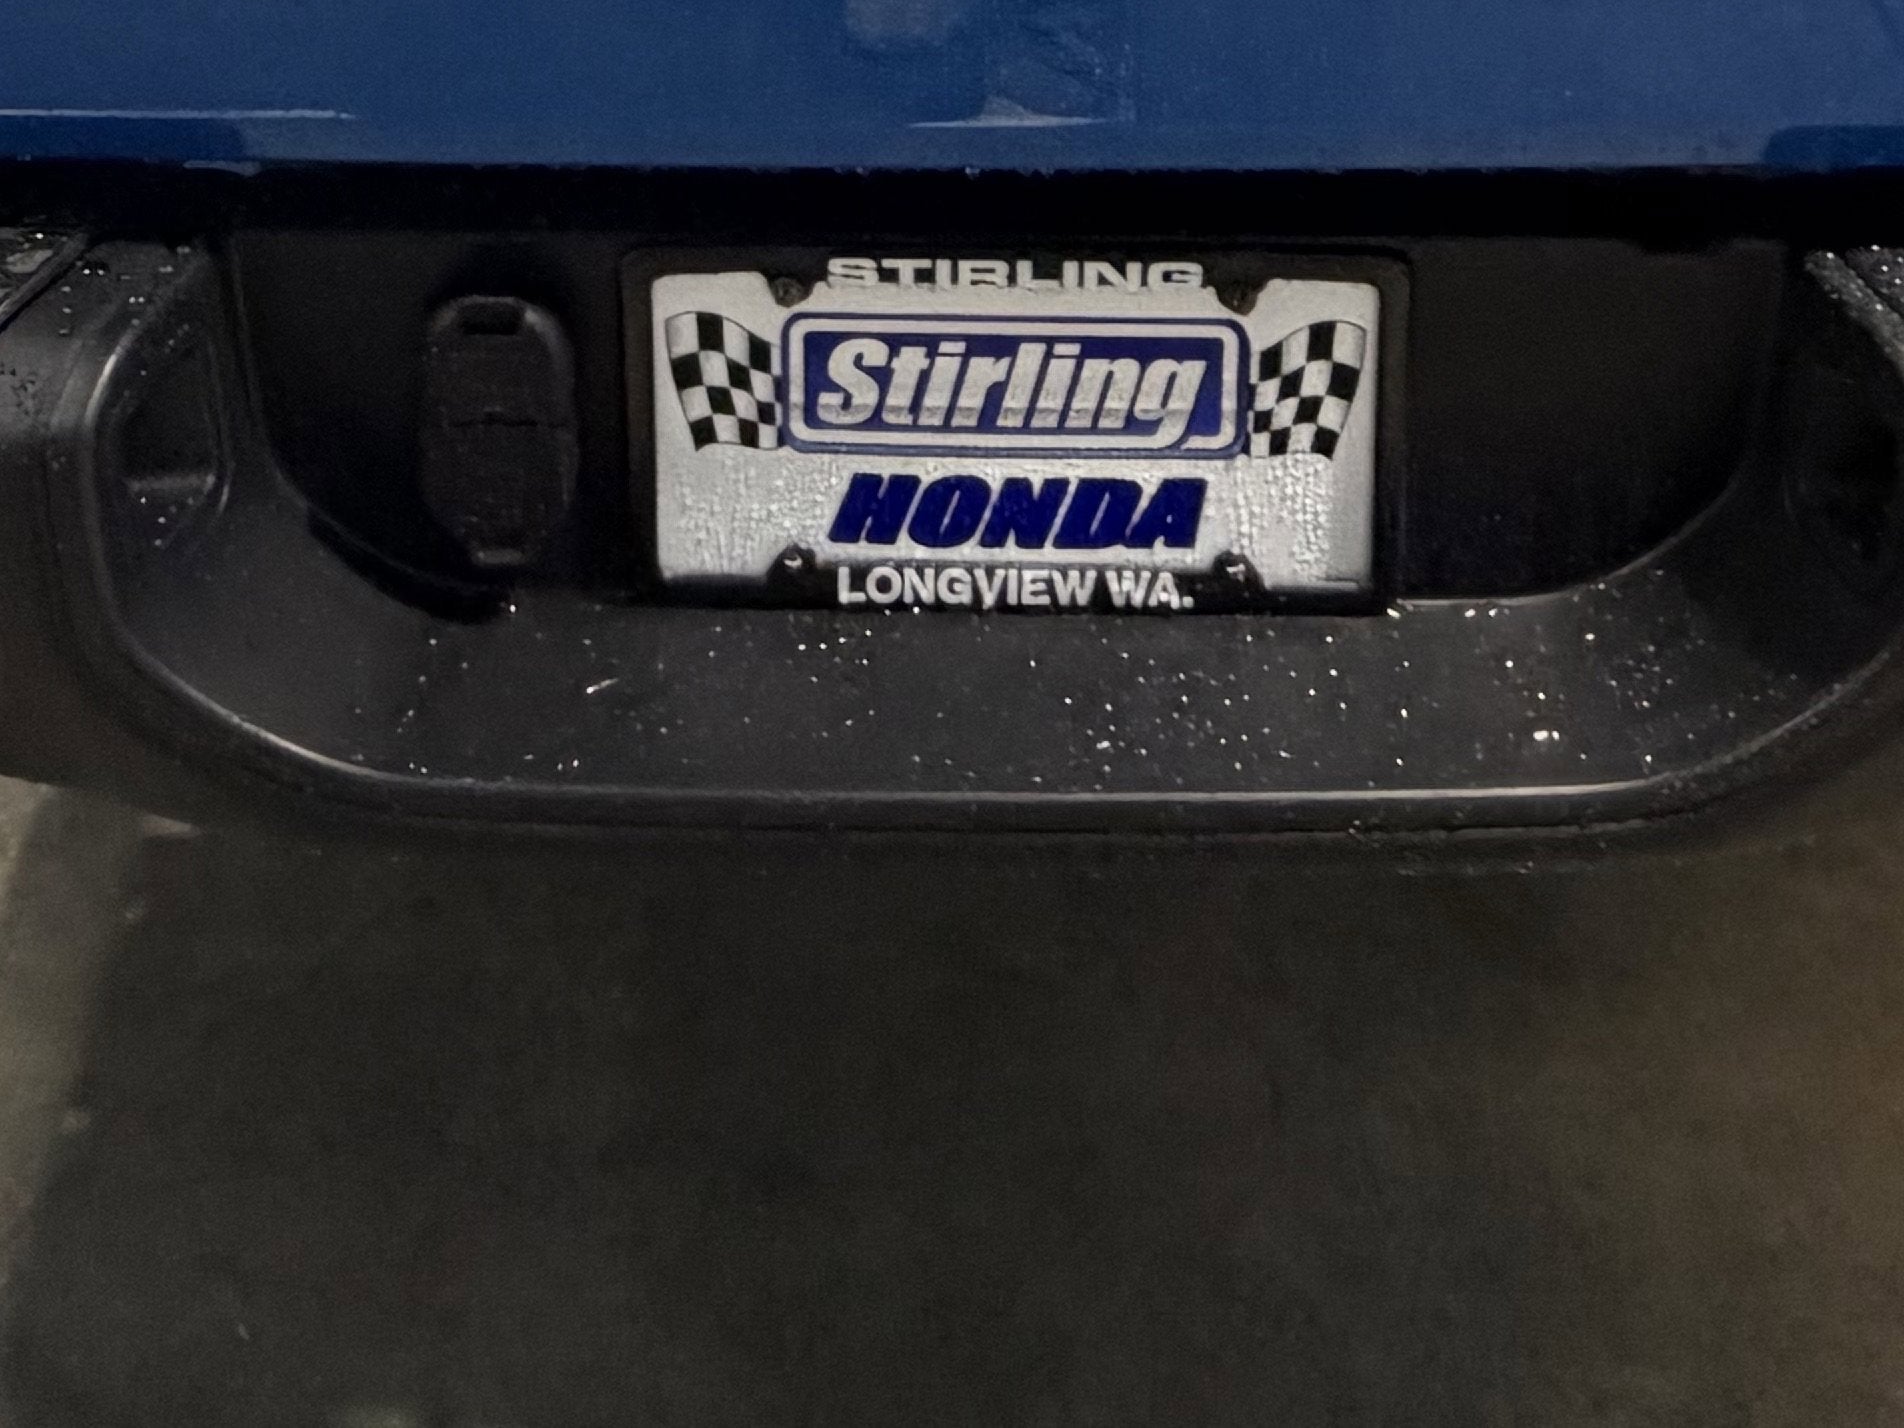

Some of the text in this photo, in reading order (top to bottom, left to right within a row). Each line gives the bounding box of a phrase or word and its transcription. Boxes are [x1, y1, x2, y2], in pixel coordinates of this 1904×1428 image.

[816, 338, 1208, 450] Stirling
[829, 473, 1208, 548] HONDA
[836, 565, 1195, 610] LONGVIEW WA.
